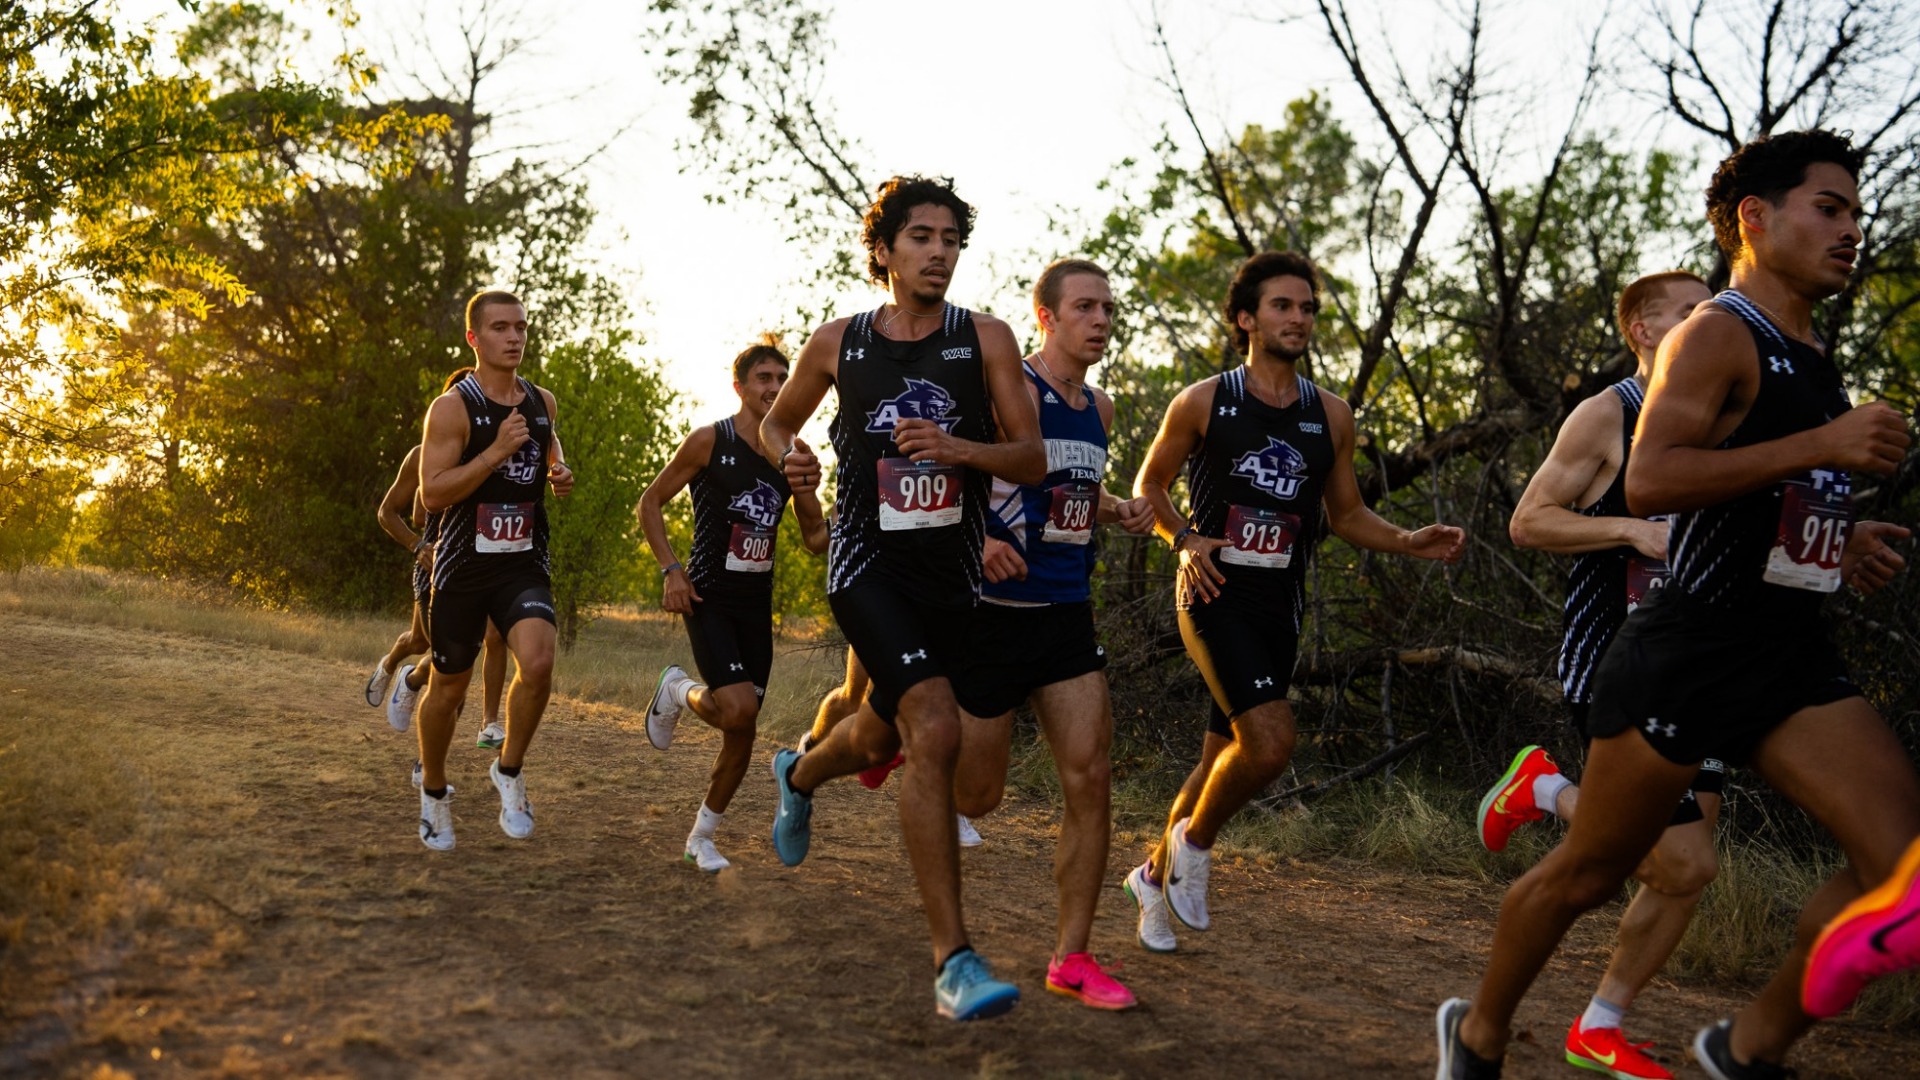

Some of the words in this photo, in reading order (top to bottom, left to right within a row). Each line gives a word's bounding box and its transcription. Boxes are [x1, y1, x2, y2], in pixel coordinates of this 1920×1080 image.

[941, 348, 972, 360] WAC
[1070, 468, 1100, 483] TEXAS
[1238, 456, 1297, 496] ACU
[900, 474, 947, 508] 909
[735, 494, 775, 526] ACU
[1062, 500, 1090, 528] 938
[492, 515, 524, 539] 912
[1240, 522, 1281, 551] 913
[1800, 515, 1848, 564] 915
[742, 537, 769, 559] 908
